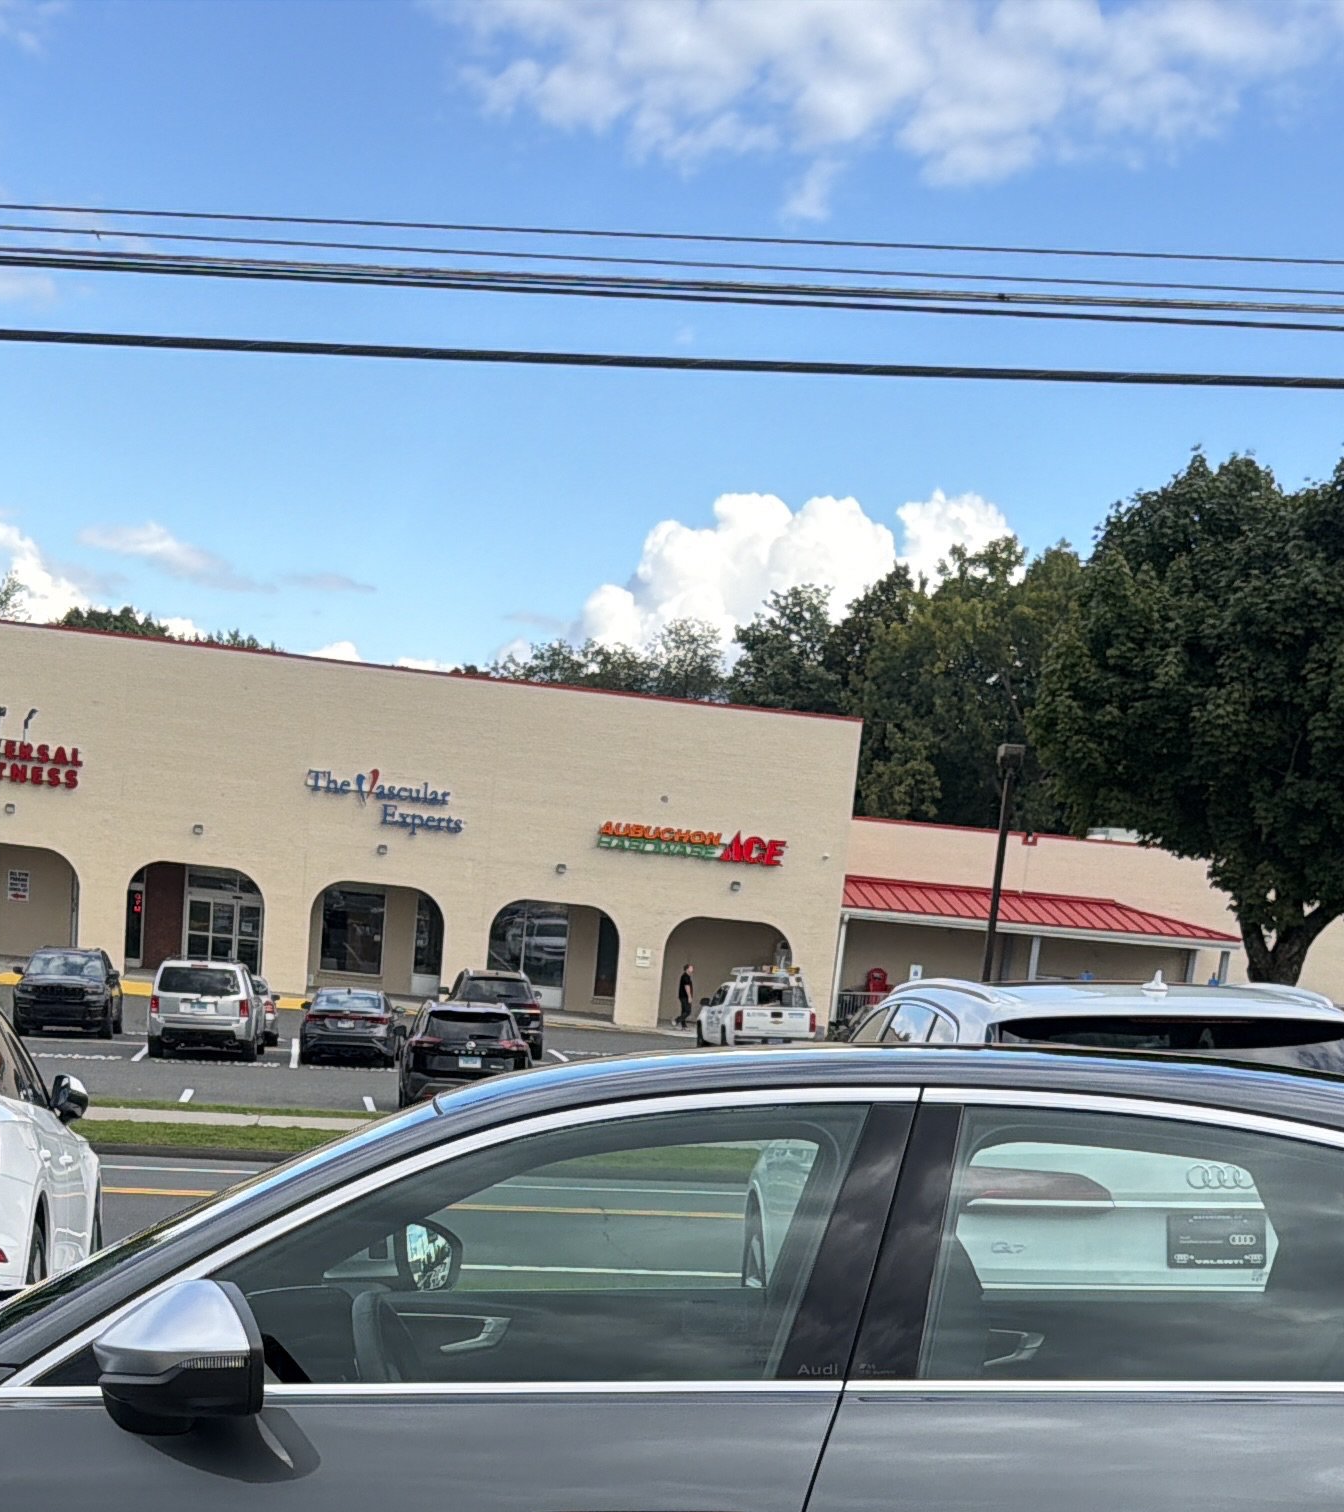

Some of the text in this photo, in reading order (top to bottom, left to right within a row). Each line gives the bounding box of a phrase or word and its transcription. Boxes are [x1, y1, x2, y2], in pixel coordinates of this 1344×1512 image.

[306, 768, 450, 806] The Vascular
[381, 803, 464, 836] Experts
[599, 820, 723, 846] AUBUCHON
[720, 830, 787, 866] ACE
[797, 1364, 838, 1375] Audi
